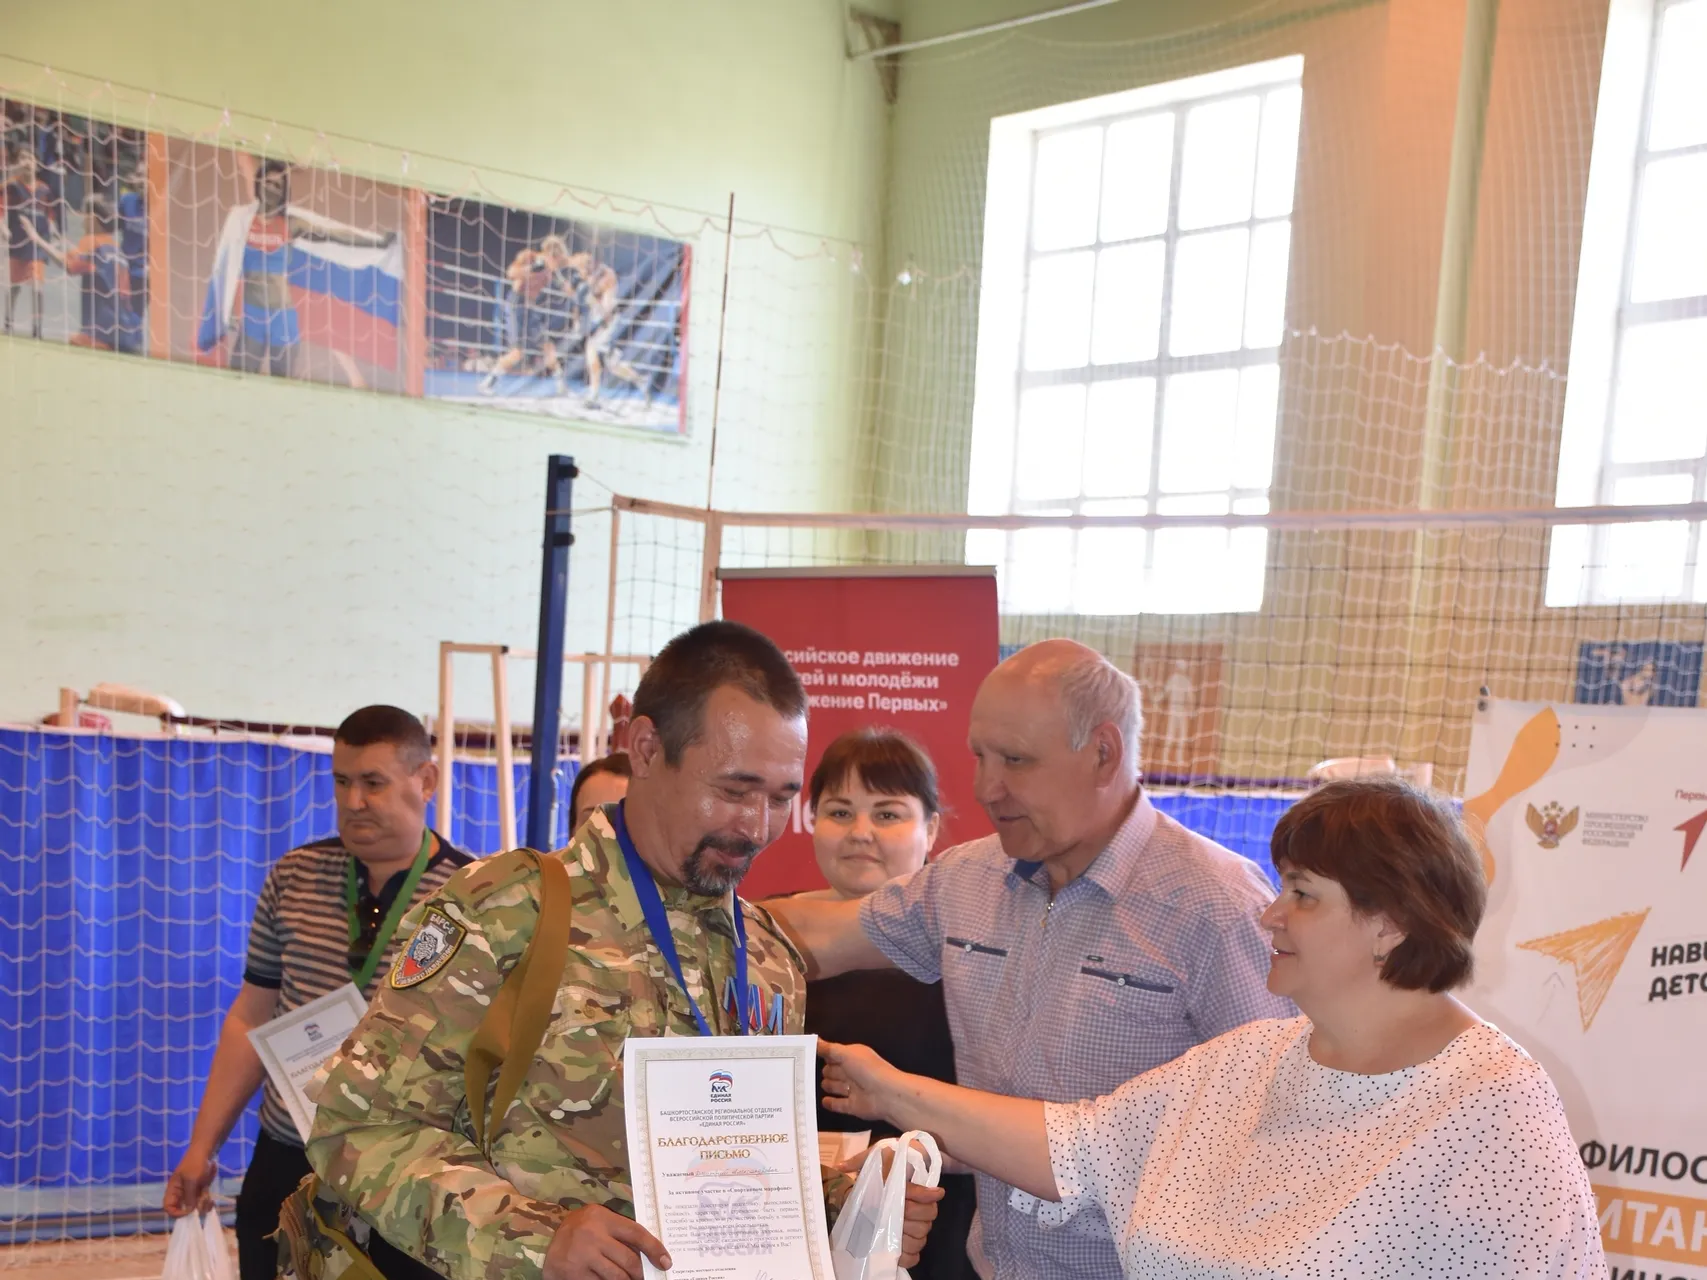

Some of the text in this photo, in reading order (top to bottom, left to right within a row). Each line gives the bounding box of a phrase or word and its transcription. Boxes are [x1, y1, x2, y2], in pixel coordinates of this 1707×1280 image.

[863, 651, 960, 668] движение
[827, 673, 839, 686] и
[842, 671, 940, 690] молодёжи
[868, 693, 948, 714] Первых»
[1651, 942, 1707, 968] НАВ
[669, 1114, 714, 1122] ВСЕРОССИЙСКОЙ
[657, 1133, 789, 1148] БЛАГОДАРСТВЕННОЕ
[700, 1149, 751, 1160] ПИСЬМО
